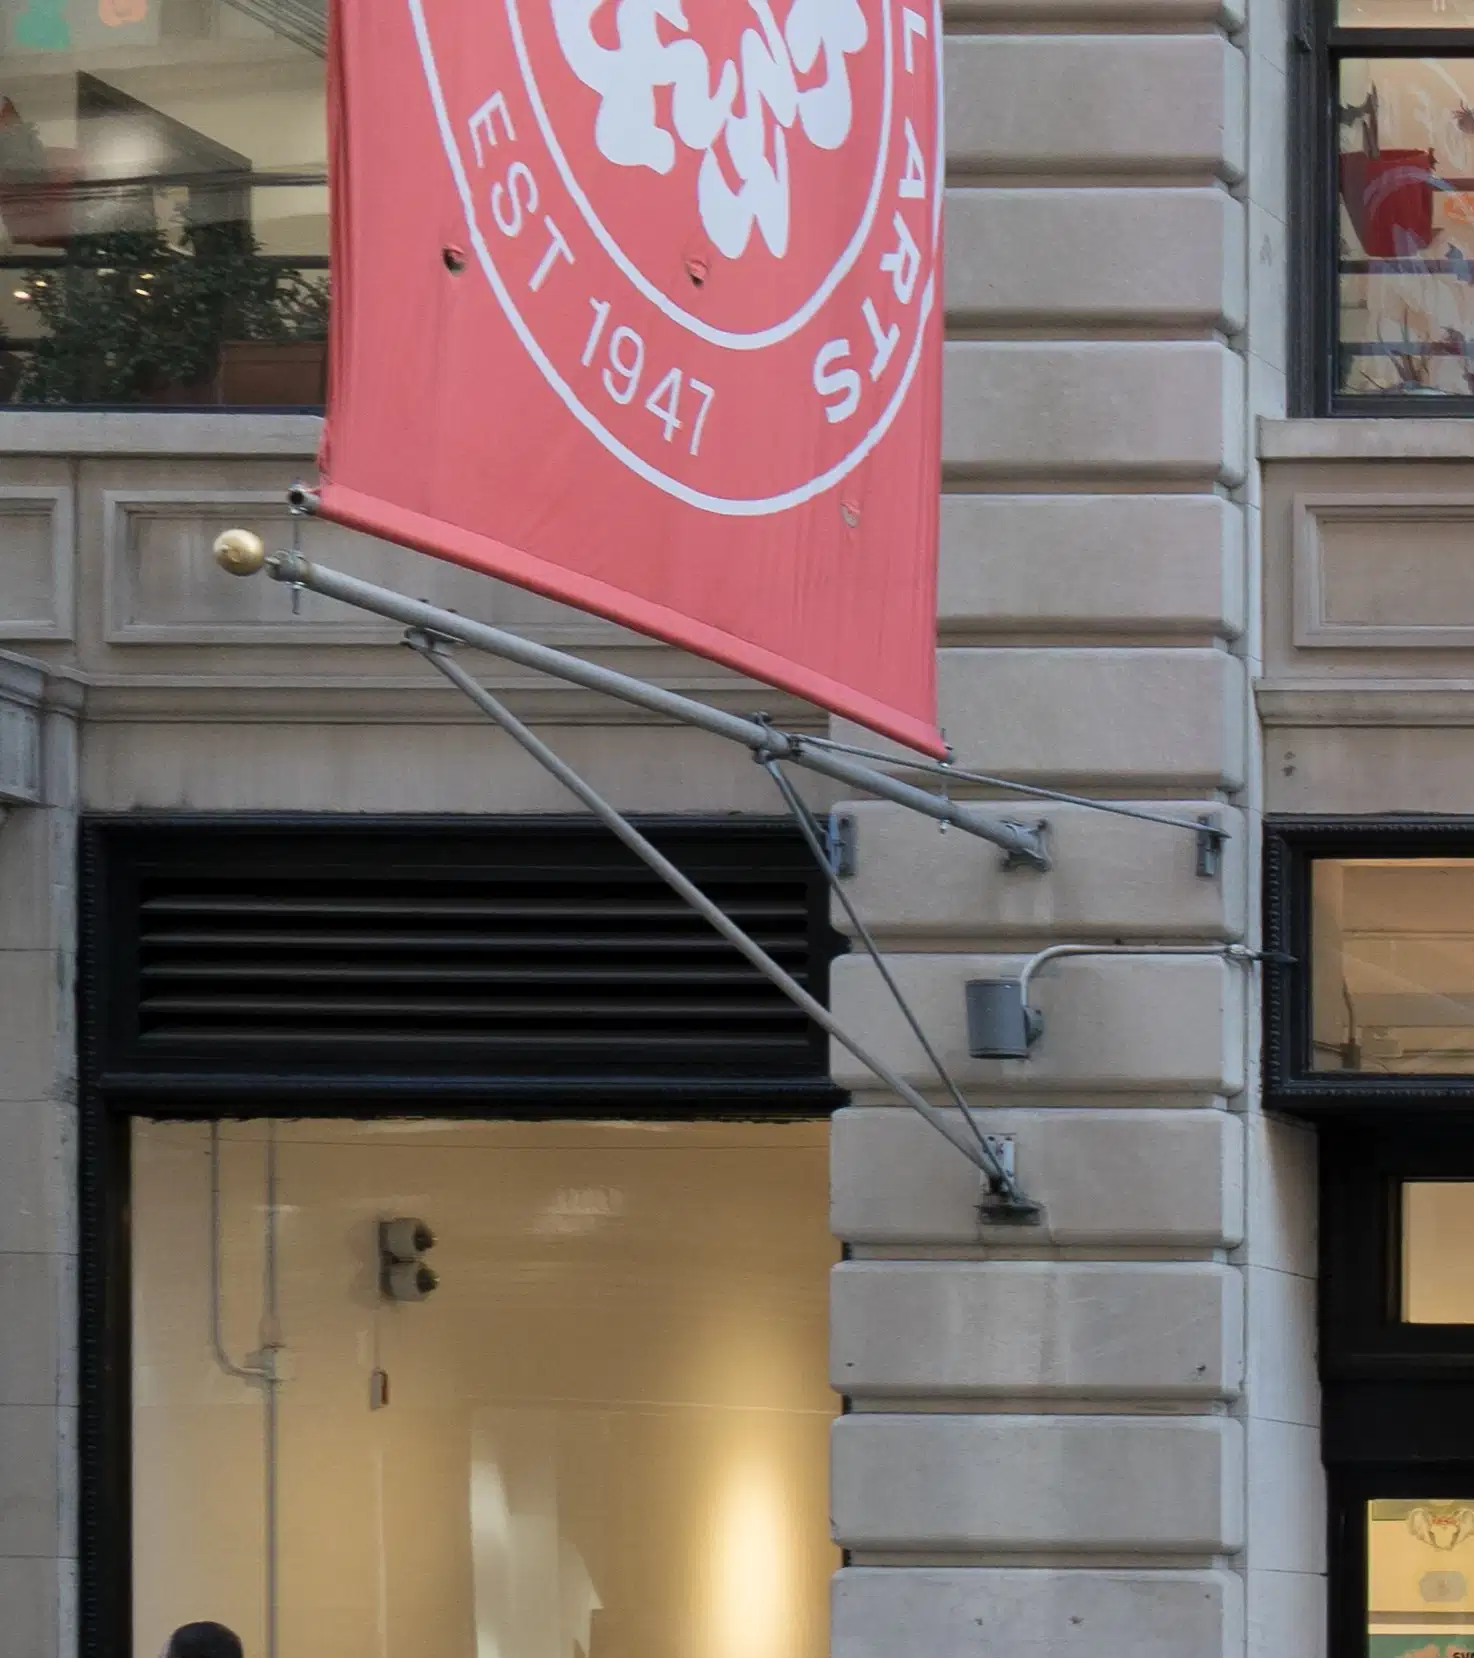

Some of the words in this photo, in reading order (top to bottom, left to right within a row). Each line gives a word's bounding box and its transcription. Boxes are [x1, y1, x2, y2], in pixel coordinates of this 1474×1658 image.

[467, 90, 575, 292] EST
[579, 296, 716, 456] 1947
[812, 117, 927, 424] ARTS
